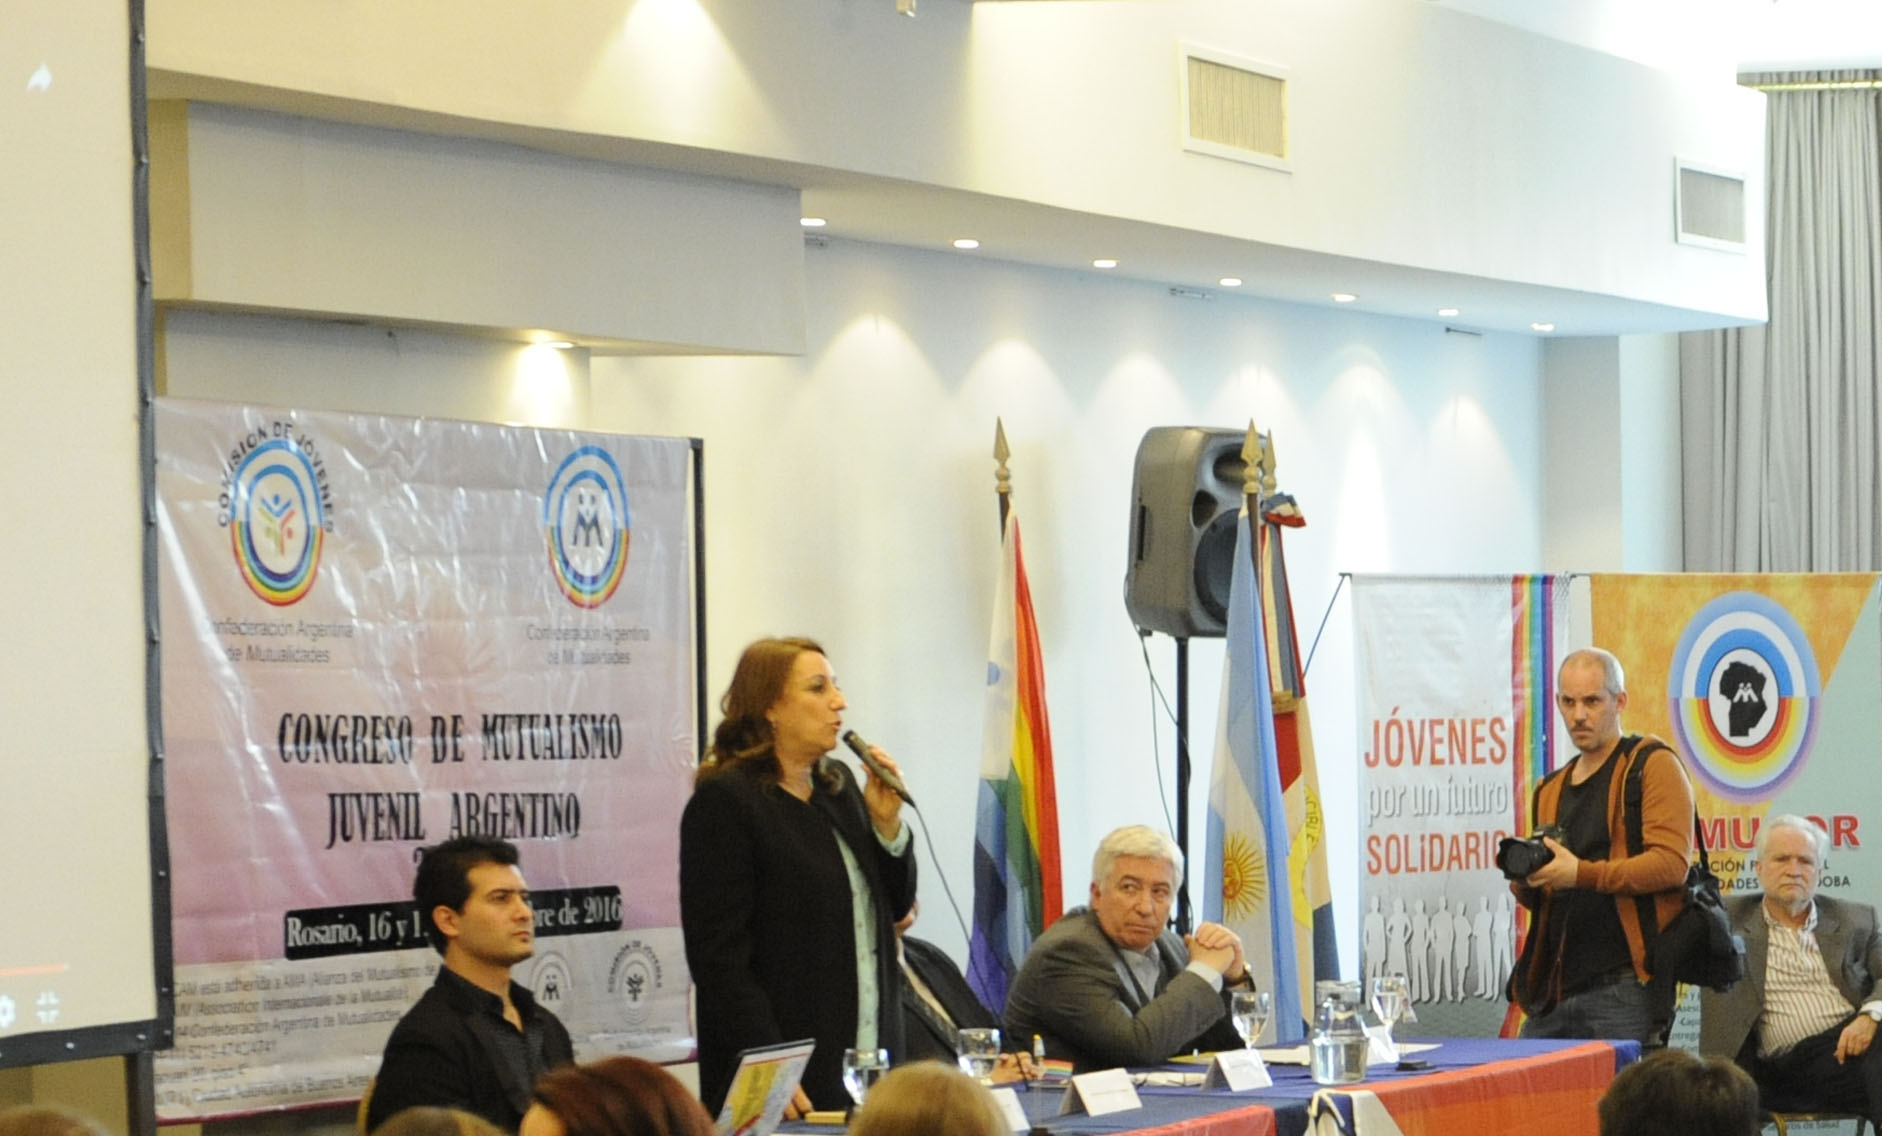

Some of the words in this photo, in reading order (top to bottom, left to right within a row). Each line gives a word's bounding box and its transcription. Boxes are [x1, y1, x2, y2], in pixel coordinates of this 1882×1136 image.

[273, 421, 294, 438] DE
[278, 713, 413, 764] CONGRESO
[431, 714, 464, 764] DE
[481, 713, 623, 761] MUTUALISMO
[1364, 707, 1508, 769] JÓVENES
[326, 791, 427, 849] JUVENIL
[449, 791, 582, 841] ARGENTINO
[1367, 780, 1406, 828] por
[1411, 783, 1439, 818] un
[1445, 774, 1508, 816] futuro
[287, 914, 363, 948] Rosario,
[369, 910, 391, 941] 16
[396, 919, 407, 946] y
[413, 909, 429, 939] 1
[558, 898, 579, 926] de
[583, 895, 623, 923] 2016
